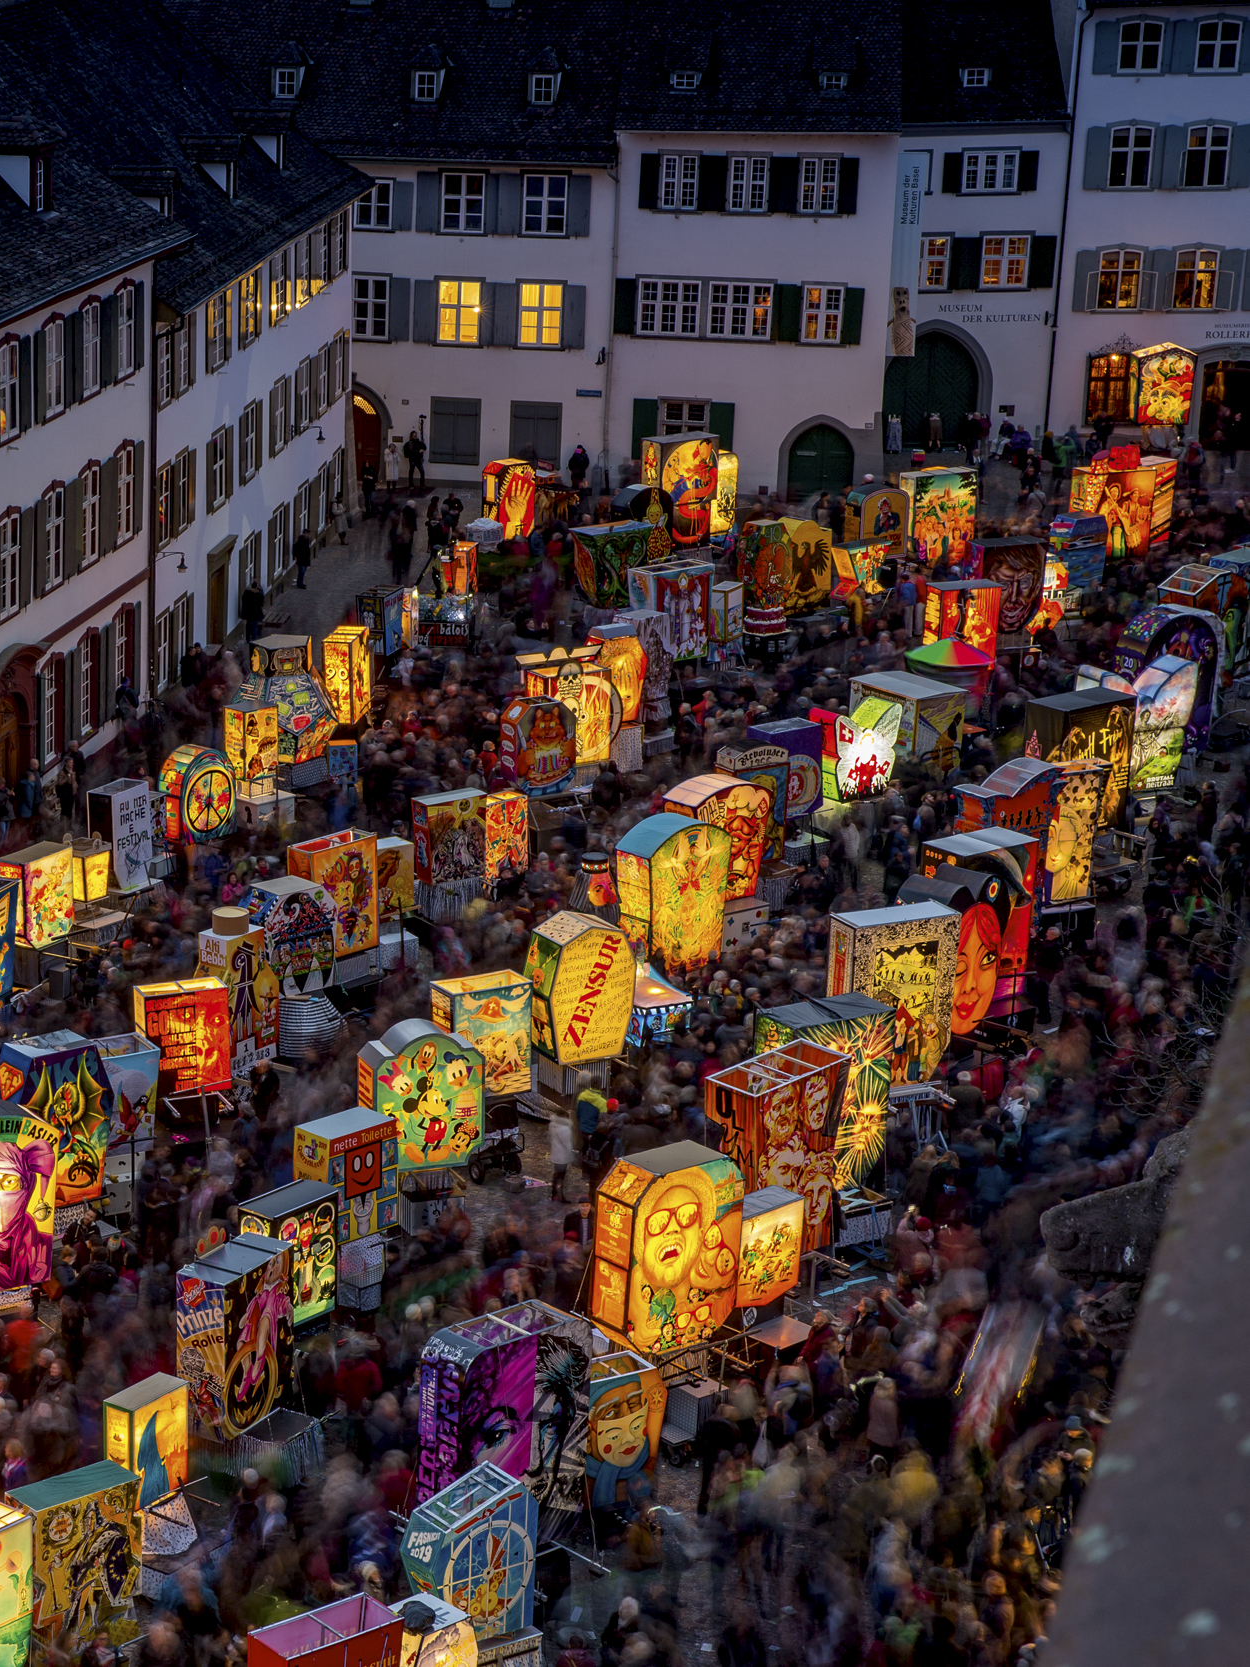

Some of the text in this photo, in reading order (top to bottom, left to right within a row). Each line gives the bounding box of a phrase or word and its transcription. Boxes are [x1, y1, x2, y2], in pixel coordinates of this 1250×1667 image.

[909, 166, 920, 225] Kulturen Basel
[900, 190, 909, 225] Museum
[938, 304, 983, 312] MUSEUM
[962, 313, 1041, 323] DER KULTUREN
[1123, 656, 1134, 669] 20
[325, 667, 349, 681] 90
[120, 802, 129, 813] AU
[120, 807, 146, 826] MACHE
[129, 824, 134, 833] E
[117, 830, 150, 851] FESTIVAL
[204, 938, 220, 953] Alti
[201, 950, 226, 968] Bebbi
[563, 935, 622, 1048] ZENSUR
[334, 1126, 393, 1153] nette Toilette
[191, 1333, 225, 1349] Rolle
[410, 1545, 432, 1563] 2019
